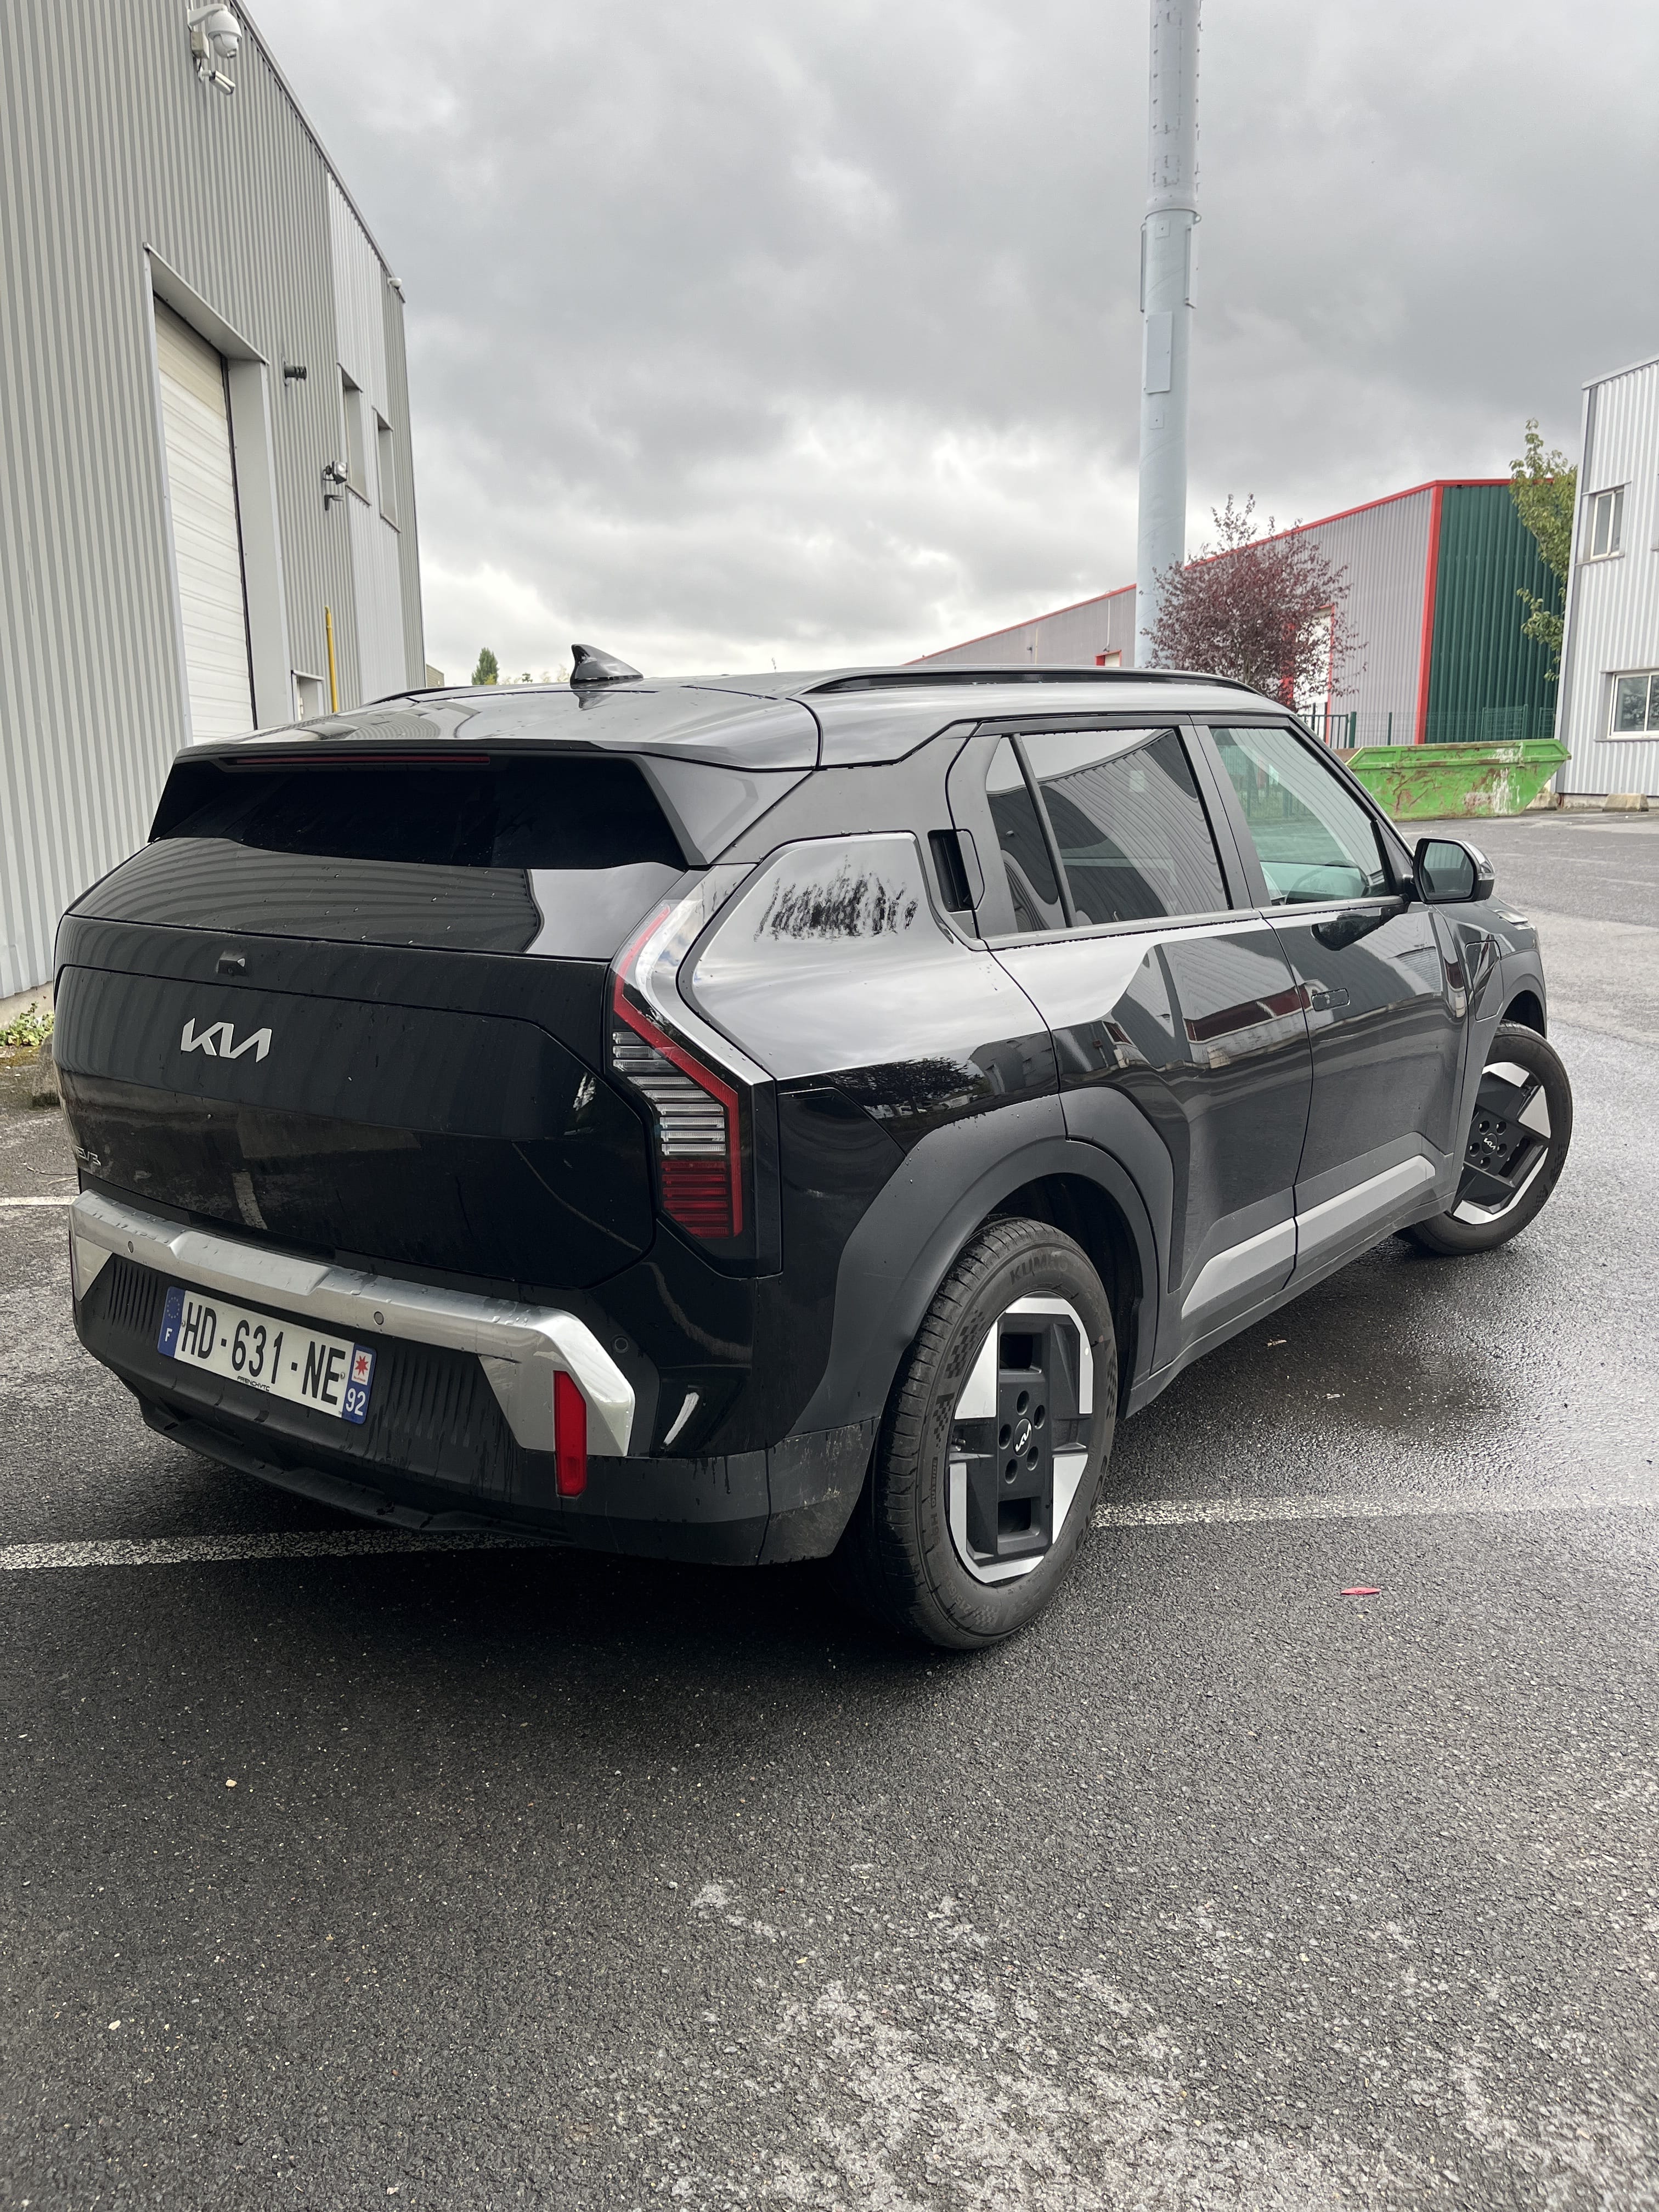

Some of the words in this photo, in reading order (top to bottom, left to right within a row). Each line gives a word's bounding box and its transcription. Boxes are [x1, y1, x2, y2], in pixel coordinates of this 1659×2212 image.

[181, 1018, 272, 1063] KIA
[164, 1327, 173, 1342] F
[346, 1387, 366, 1416] 92
[1015, 1423, 1031, 1452] KIA
